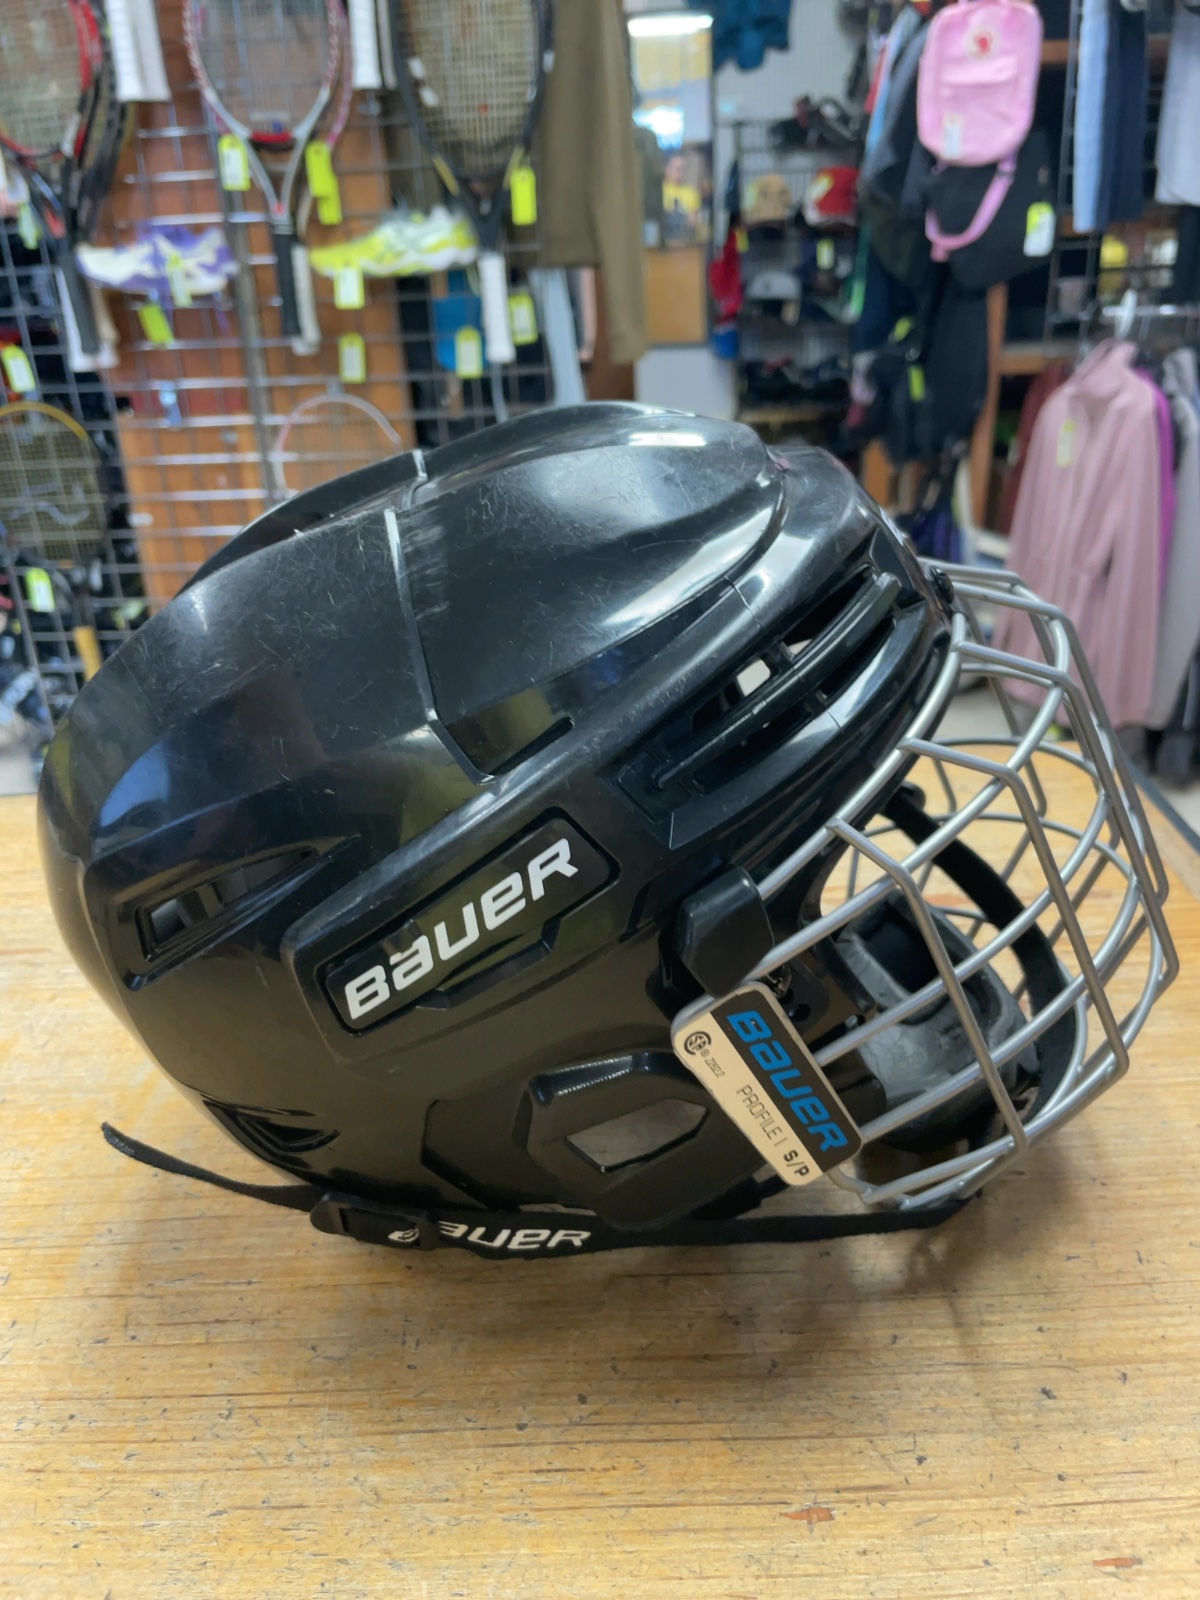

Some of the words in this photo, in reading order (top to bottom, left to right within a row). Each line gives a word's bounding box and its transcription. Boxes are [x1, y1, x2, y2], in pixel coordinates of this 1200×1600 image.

[344, 837, 579, 1019] BAUER
[726, 1010, 848, 1151] BAUER
[736, 1085, 782, 1141] PROFILE
[783, 1149, 811, 1178] S/P
